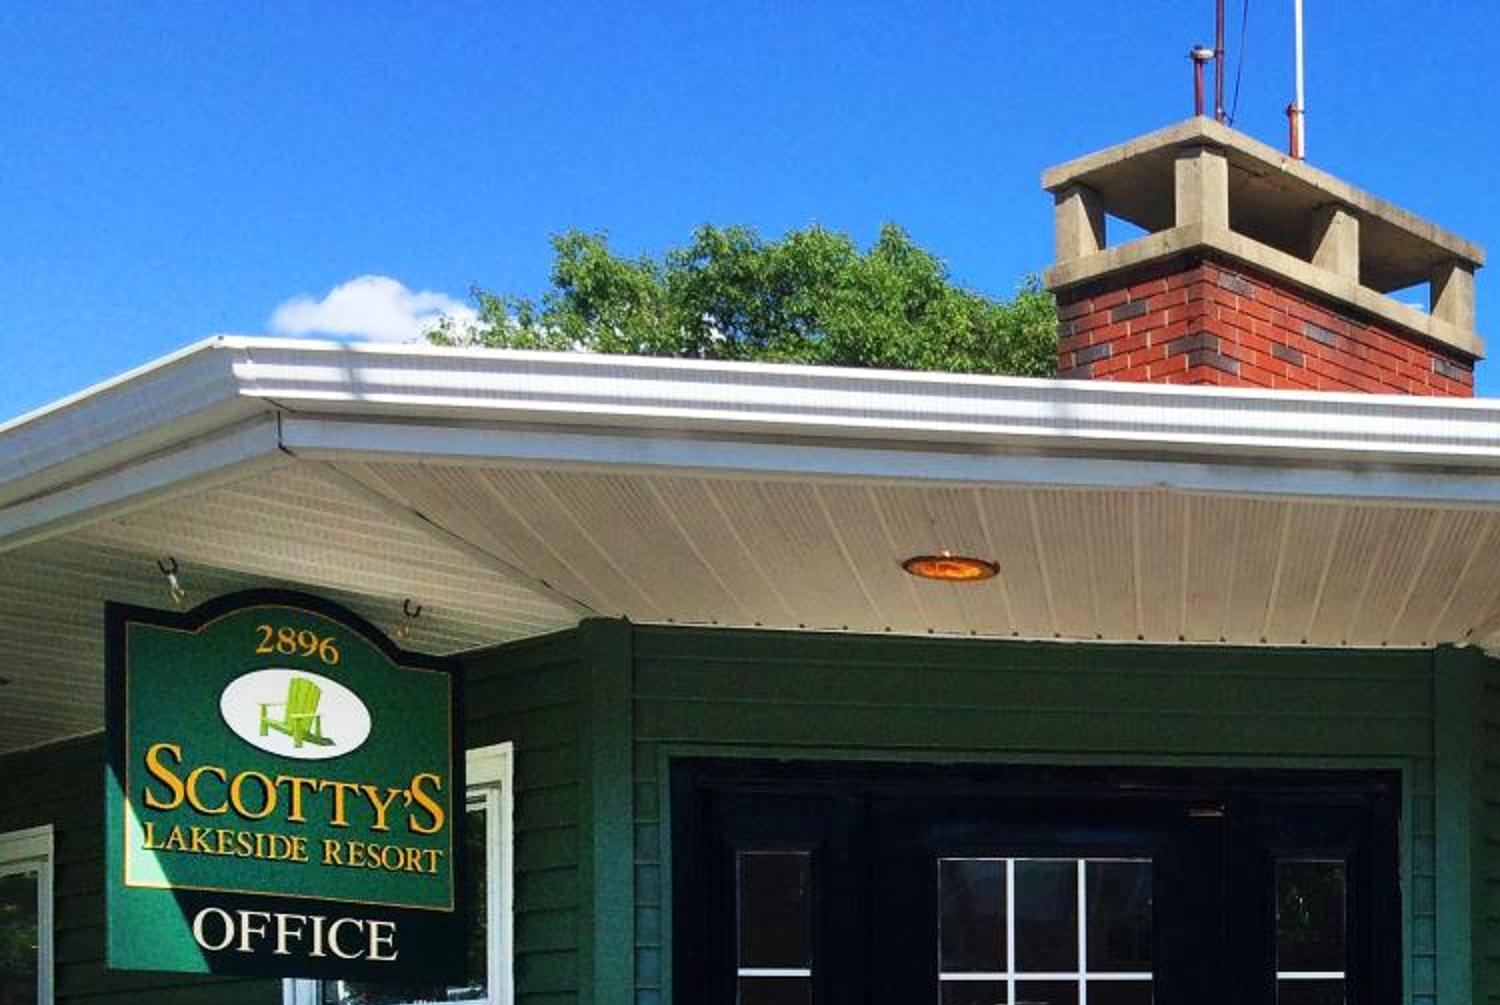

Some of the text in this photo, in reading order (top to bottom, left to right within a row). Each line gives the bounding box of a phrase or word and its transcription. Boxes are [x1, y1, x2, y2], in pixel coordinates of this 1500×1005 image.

[255, 625, 340, 665] 2896
[144, 742, 446, 834] SCOTTY'S
[143, 821, 443, 874] LAKESIDE RESORT
[193, 907, 398, 961] OFFICE
